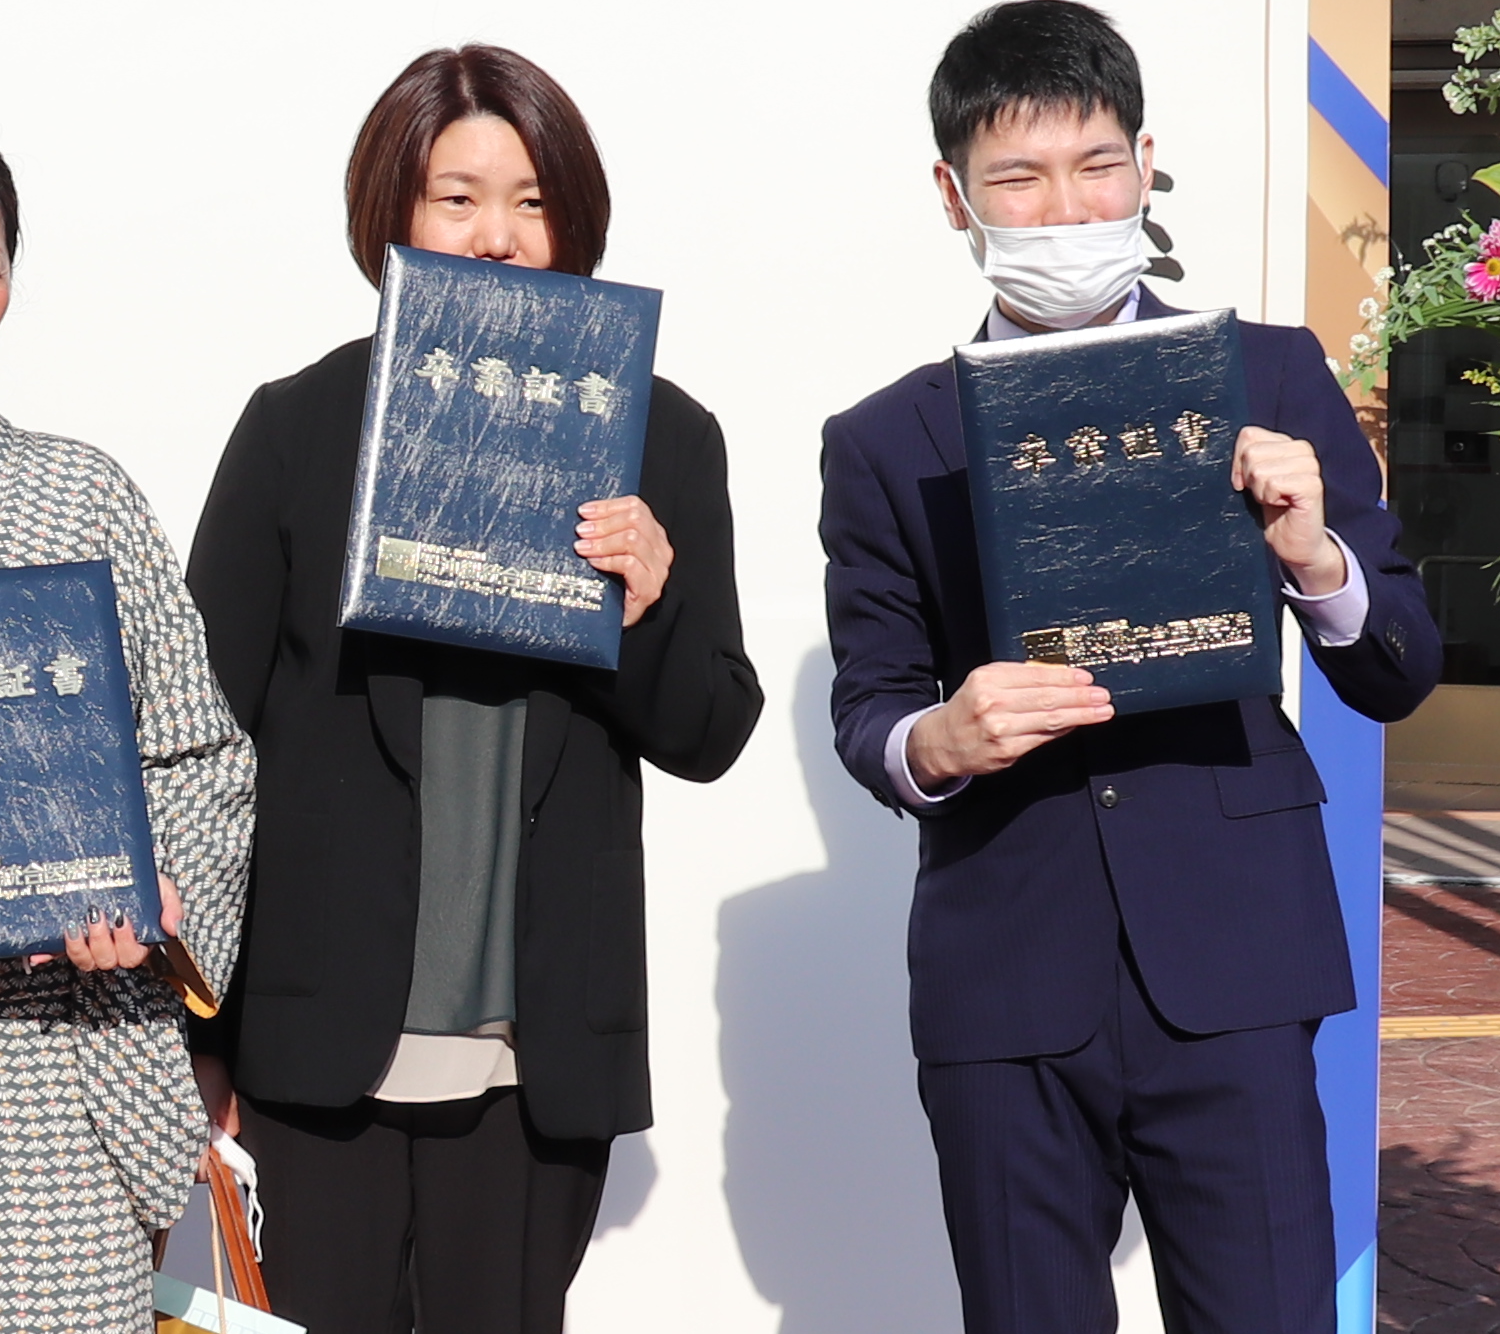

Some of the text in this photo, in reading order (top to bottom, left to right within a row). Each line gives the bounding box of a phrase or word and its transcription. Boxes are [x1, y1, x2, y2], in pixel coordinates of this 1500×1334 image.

[414, 347, 615, 417] 卒業証書
[1011, 409, 1213, 478] 卒業証書
